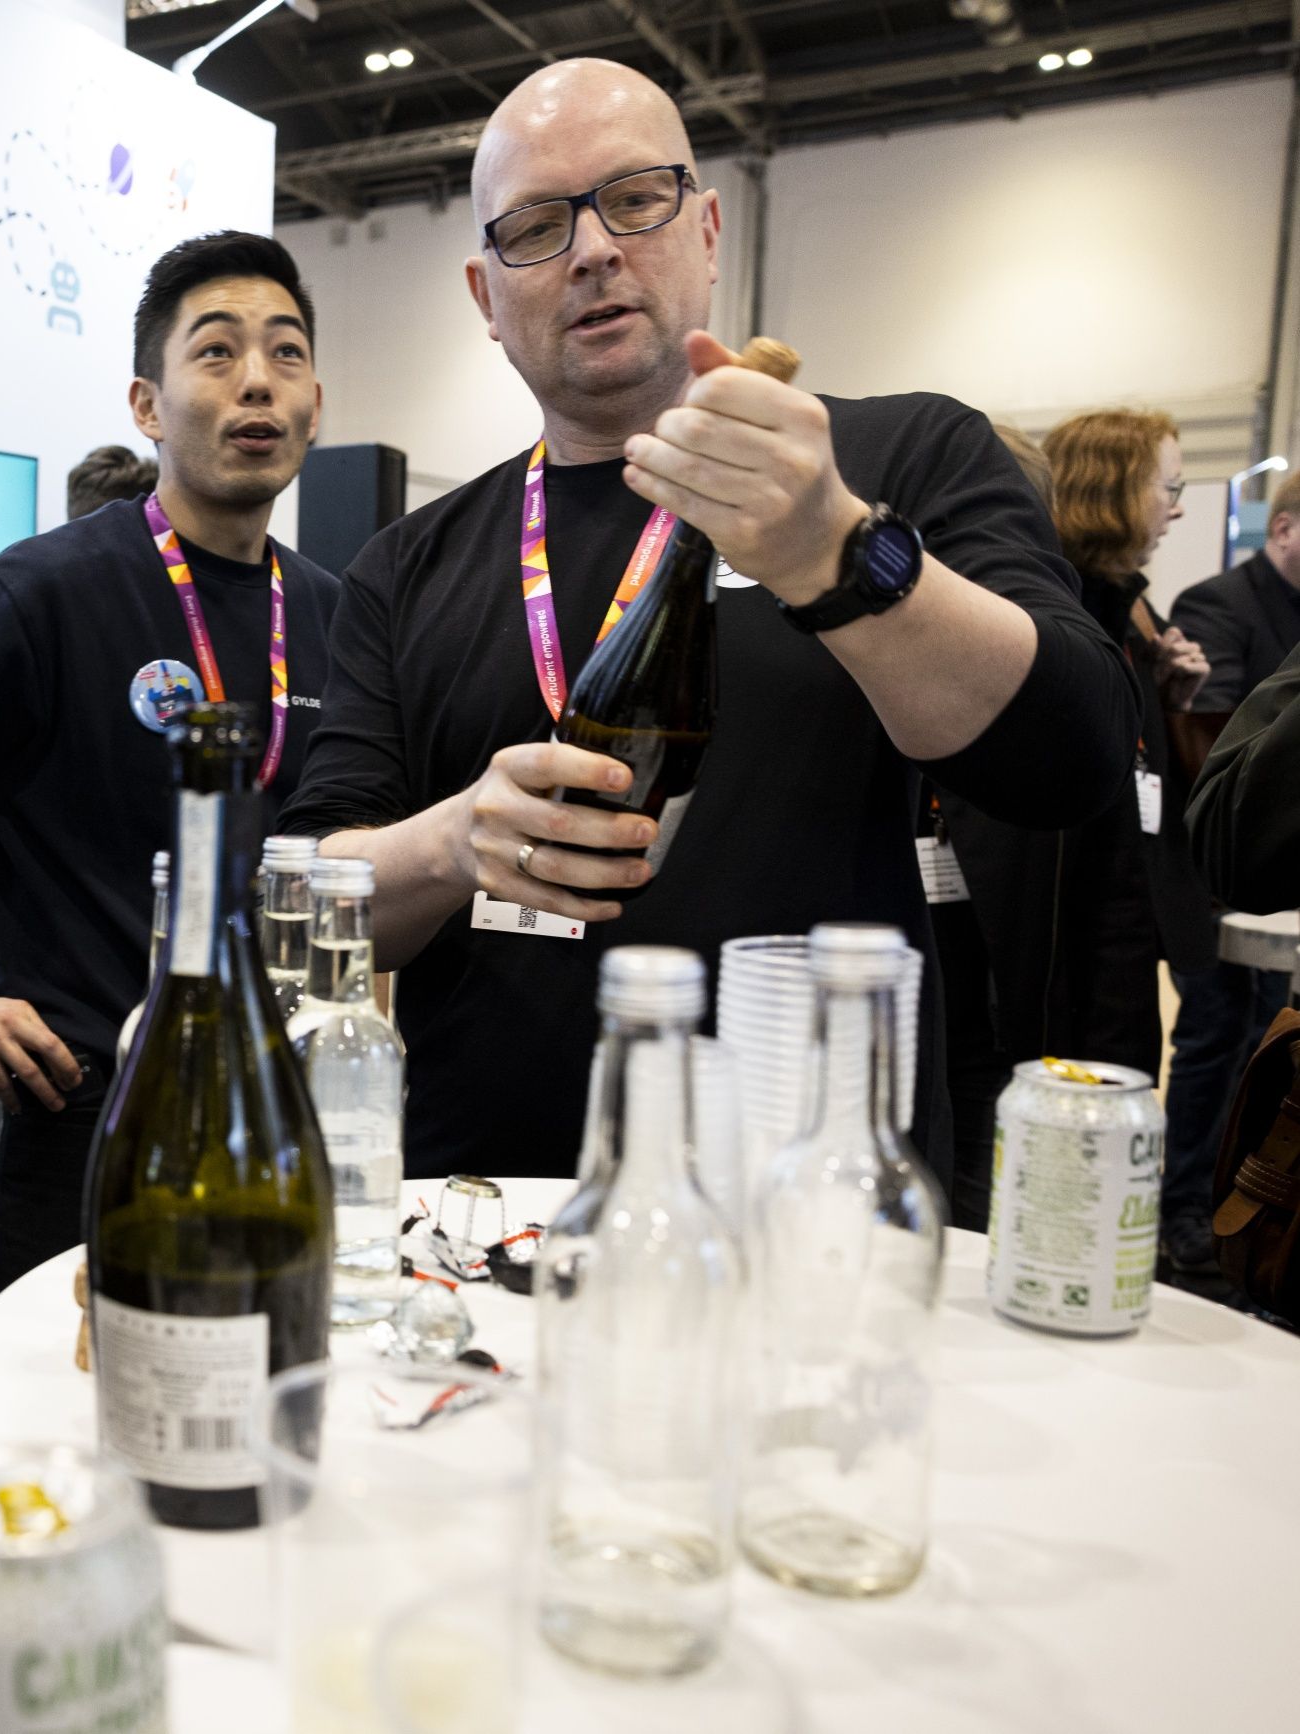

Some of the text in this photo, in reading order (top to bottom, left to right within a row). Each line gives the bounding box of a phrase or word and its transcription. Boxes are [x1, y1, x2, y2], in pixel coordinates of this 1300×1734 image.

[628, 535, 658, 587] empowered
[537, 609, 553, 659] empowered
[544, 660, 560, 695] student
